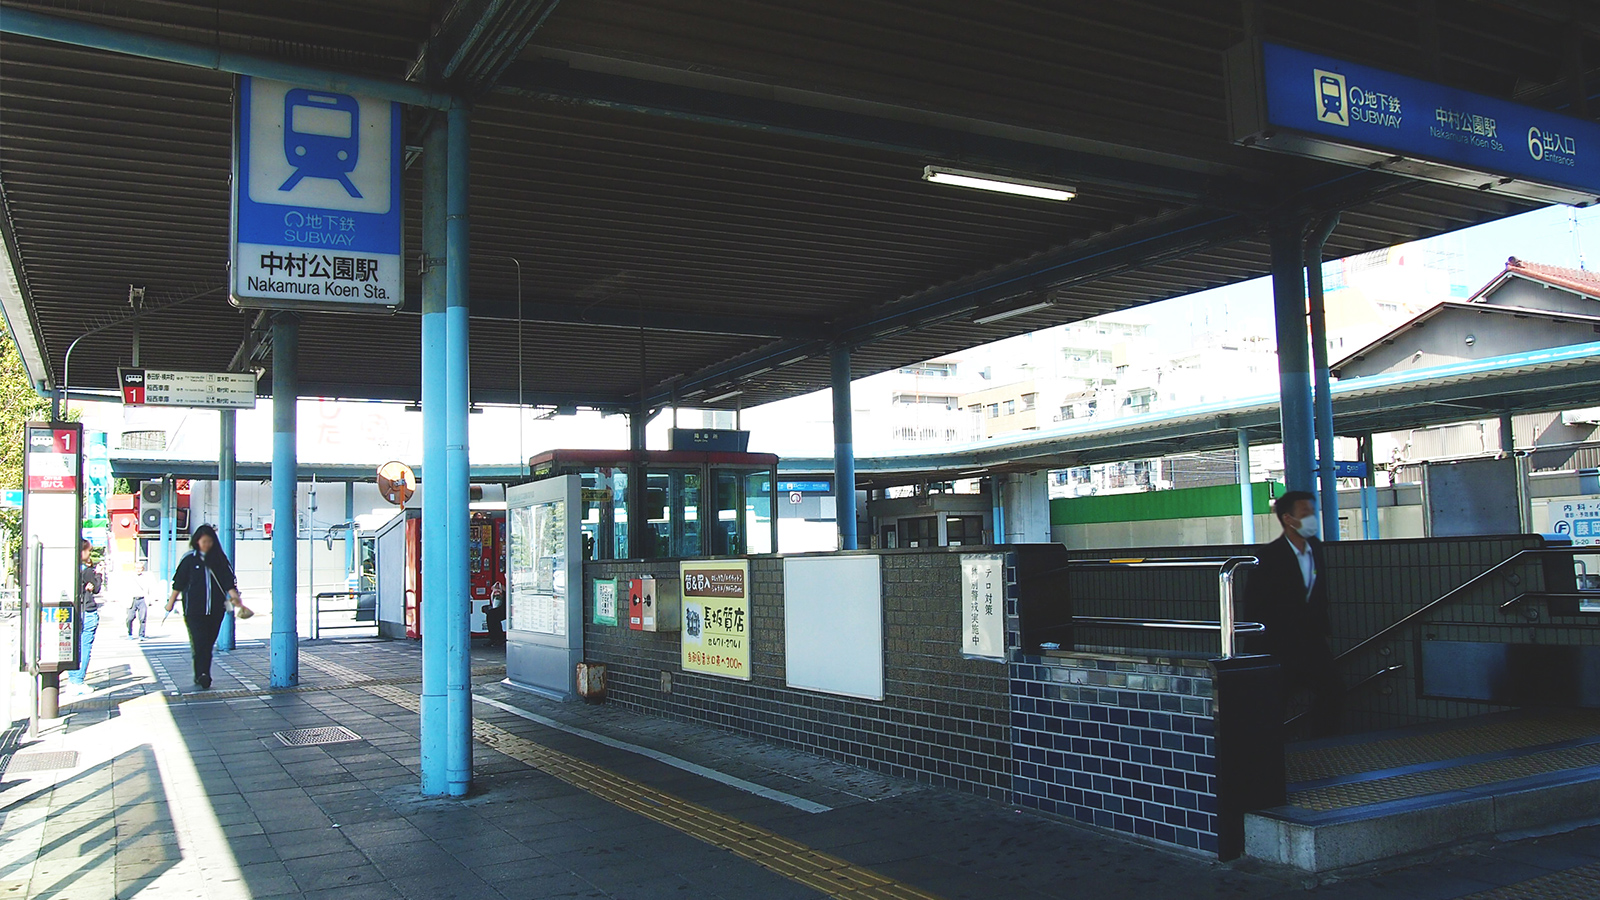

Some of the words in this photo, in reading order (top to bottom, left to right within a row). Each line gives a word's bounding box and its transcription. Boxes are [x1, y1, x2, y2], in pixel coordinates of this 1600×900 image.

[1364, 89, 1402, 114] 地下鉄
[1351, 106, 1402, 129] SUBWAY
[1435, 106, 1498, 139] 中村公園駅
[1430, 126, 1469, 145] Nakamura
[1470, 135, 1490, 148] Koen
[1490, 138, 1505, 152] Sta.
[1528, 126, 1543, 161] 6
[1543, 132, 1576, 156] 出入口
[1544, 150, 1575, 167] Entrance
[306, 213, 356, 232] 地下鉄
[284, 229, 356, 246] SUBWAY
[260, 250, 379, 283] 中村公園駅
[248, 275, 320, 296] Nakamura
[325, 281, 360, 297] Koen
[363, 284, 390, 300] Sta.
[130, 388, 137, 402] 1
[61, 433, 70, 451] 1
[41, 480, 64, 488] 市バス
[984, 568, 993, 616] テロ対策
[704, 606, 745, 632] 長坂質店
